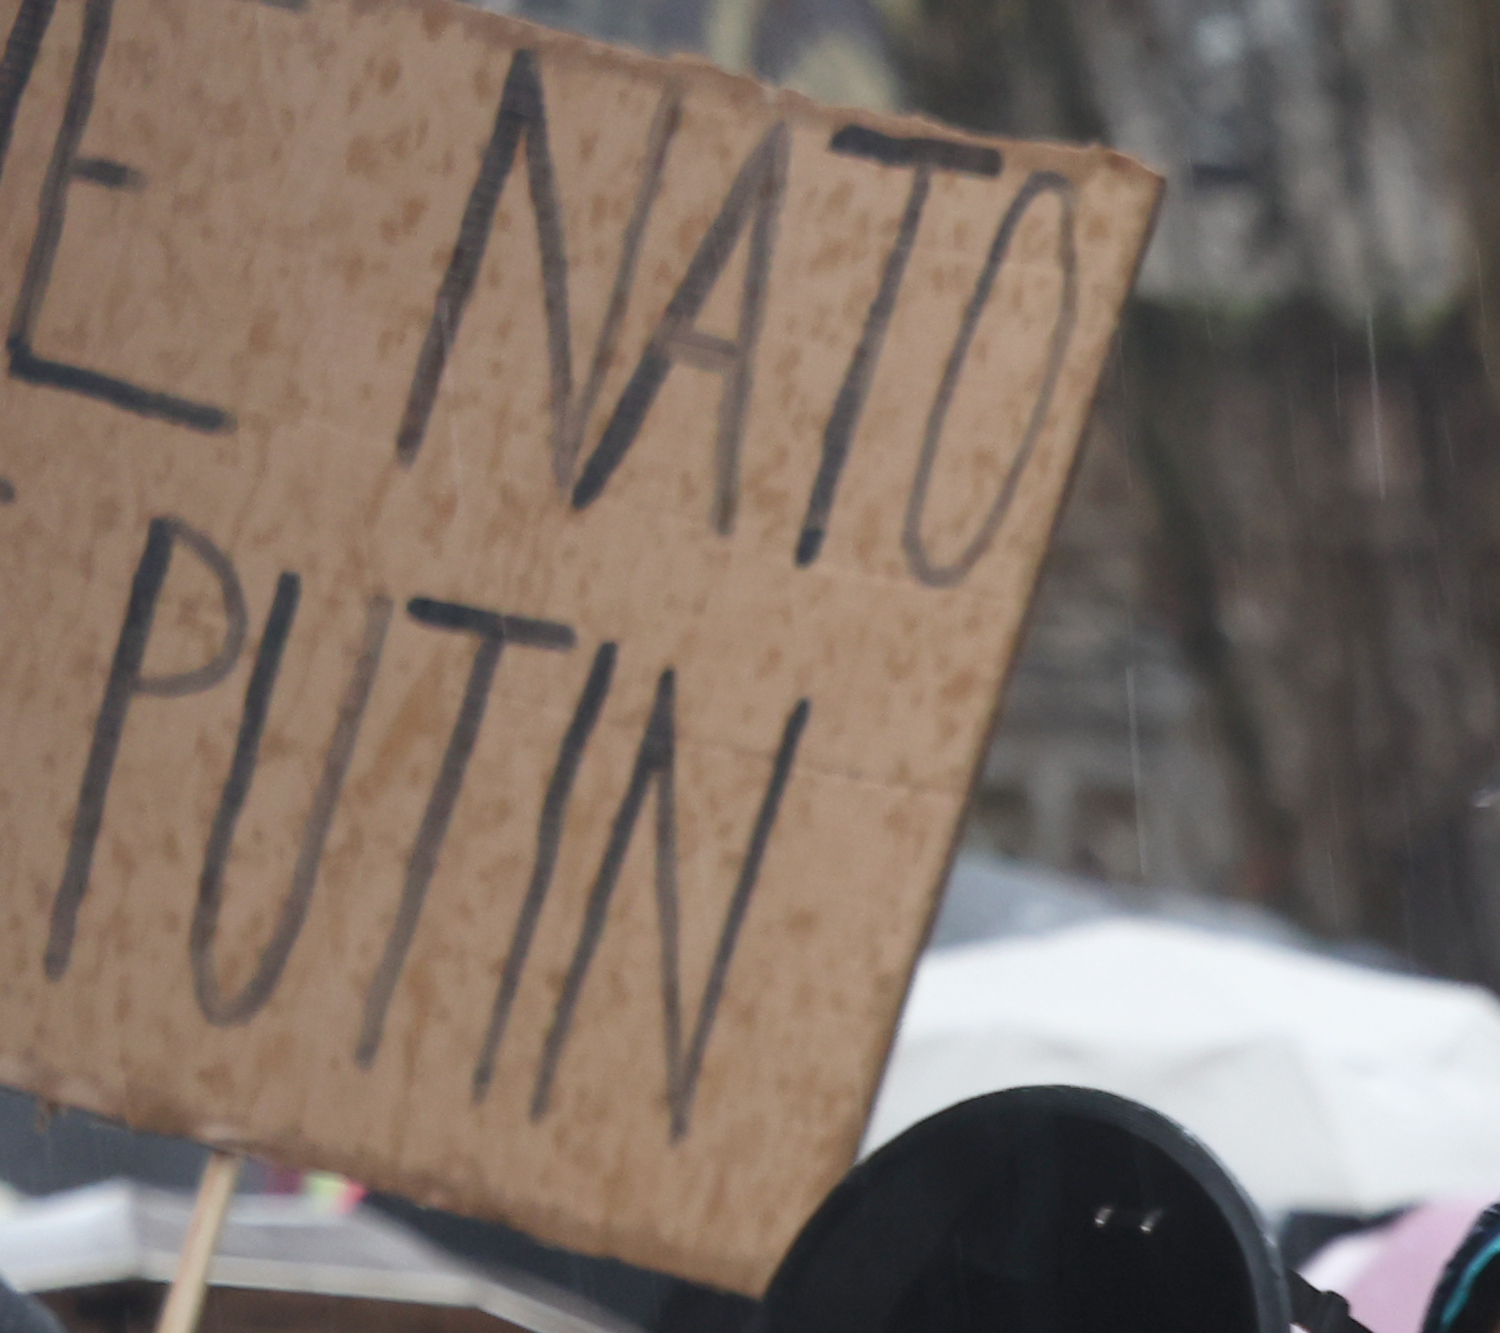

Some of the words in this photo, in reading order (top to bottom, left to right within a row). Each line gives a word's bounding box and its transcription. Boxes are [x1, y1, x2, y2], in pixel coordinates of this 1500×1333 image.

[0, 0, 238, 436] E
[398, 46, 1079, 590] NATO
[42, 515, 812, 1146] PUTIN
